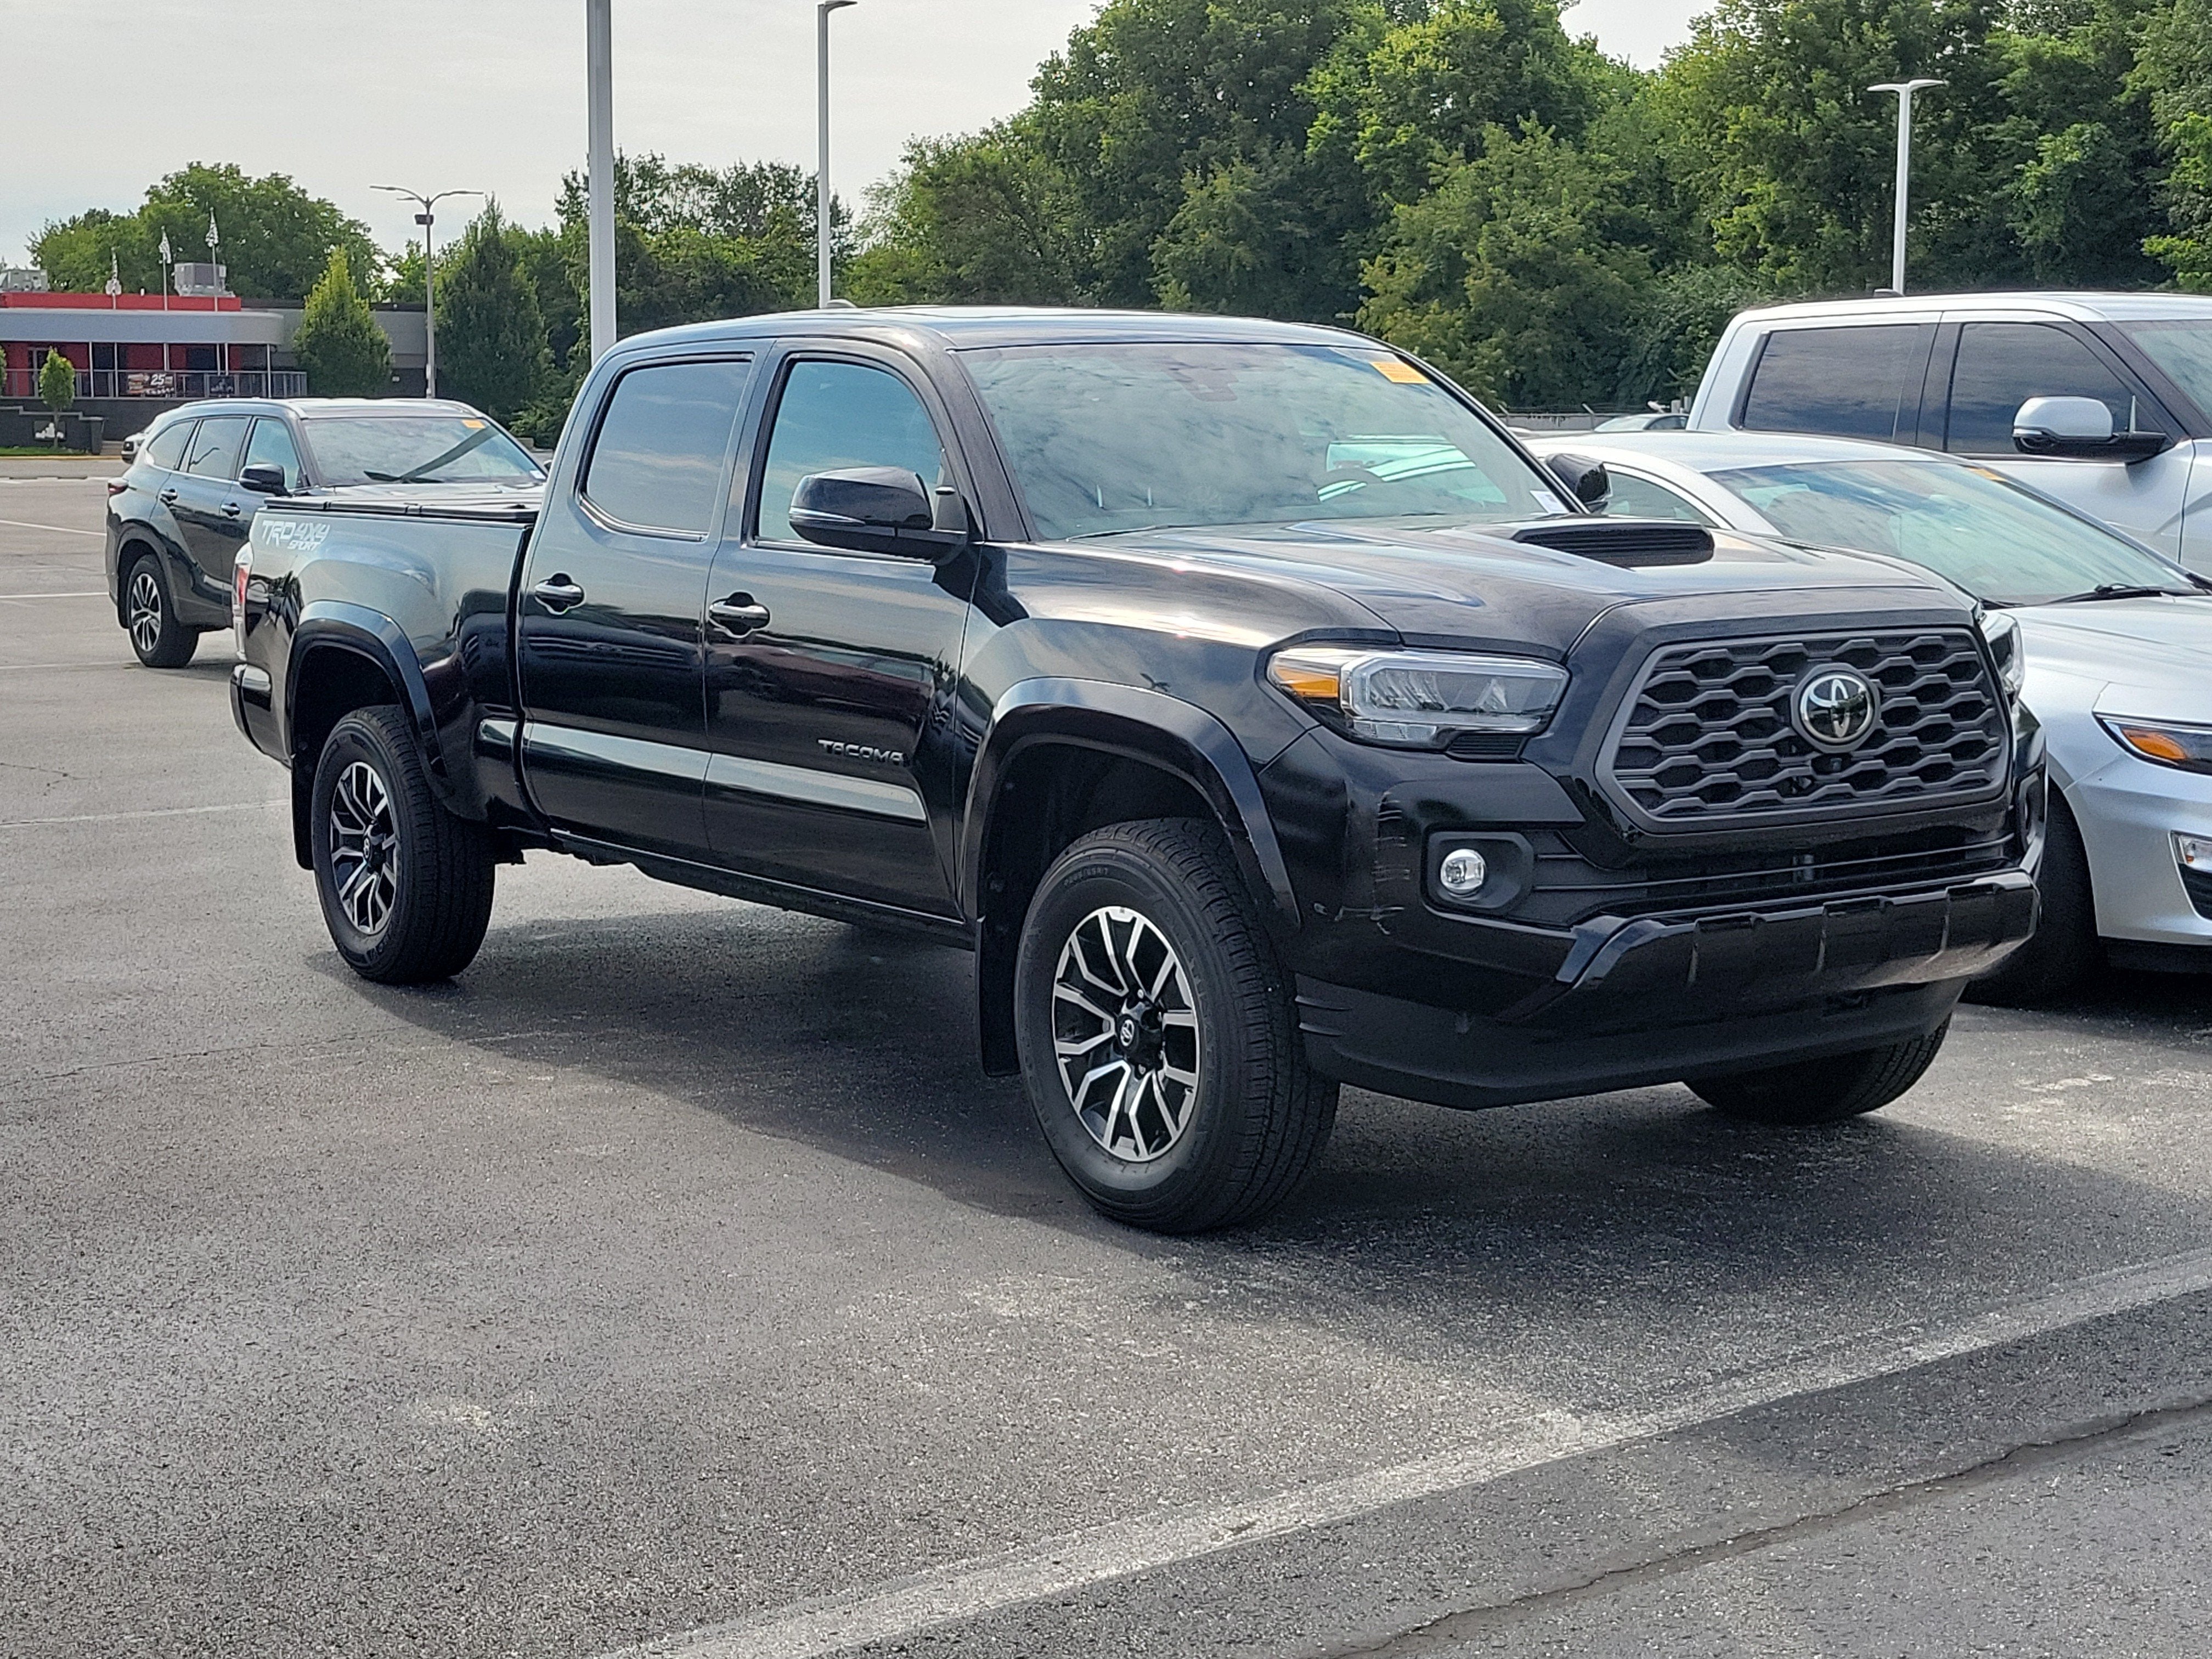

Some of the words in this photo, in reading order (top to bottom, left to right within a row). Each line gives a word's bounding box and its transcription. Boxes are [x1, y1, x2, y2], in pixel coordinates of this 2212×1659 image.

[262, 520, 296, 546] TRD
[287, 540, 321, 551] SPORT
[818, 740, 905, 763] TACOMA
